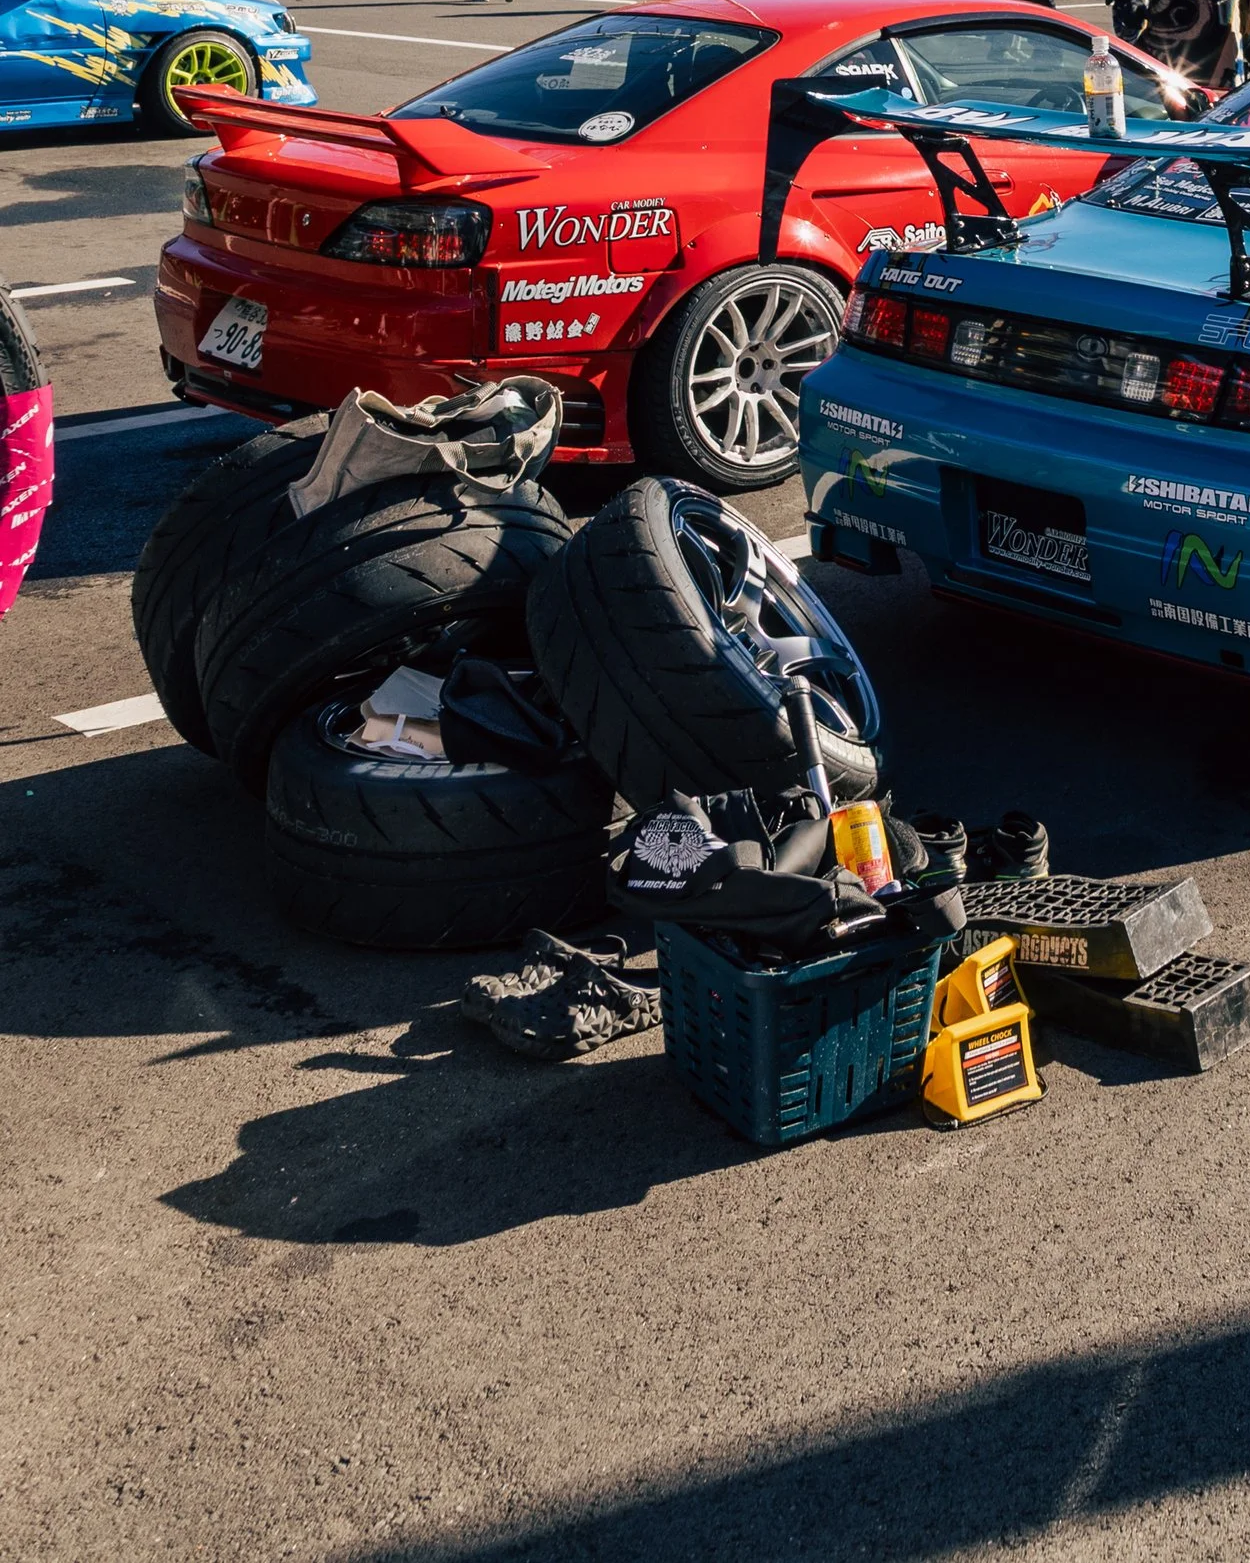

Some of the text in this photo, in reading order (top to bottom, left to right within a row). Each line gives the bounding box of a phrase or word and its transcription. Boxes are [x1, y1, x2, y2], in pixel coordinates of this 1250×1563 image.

[611, 197, 666, 211] CAR MODIFY
[516, 205, 671, 251] WONDER
[501, 275, 644, 304] Motegi Motors
[880, 267, 963, 292] HANG OUT
[828, 402, 893, 436] SHIBATA
[827, 421, 891, 447] MOTOR SPORT
[1144, 478, 1249, 513] SHIBATA
[1143, 499, 1248, 525] MOTOR SPORT
[987, 510, 1089, 571] WONDER
[968, 1028, 1013, 1050] WHEEL CHOCK
